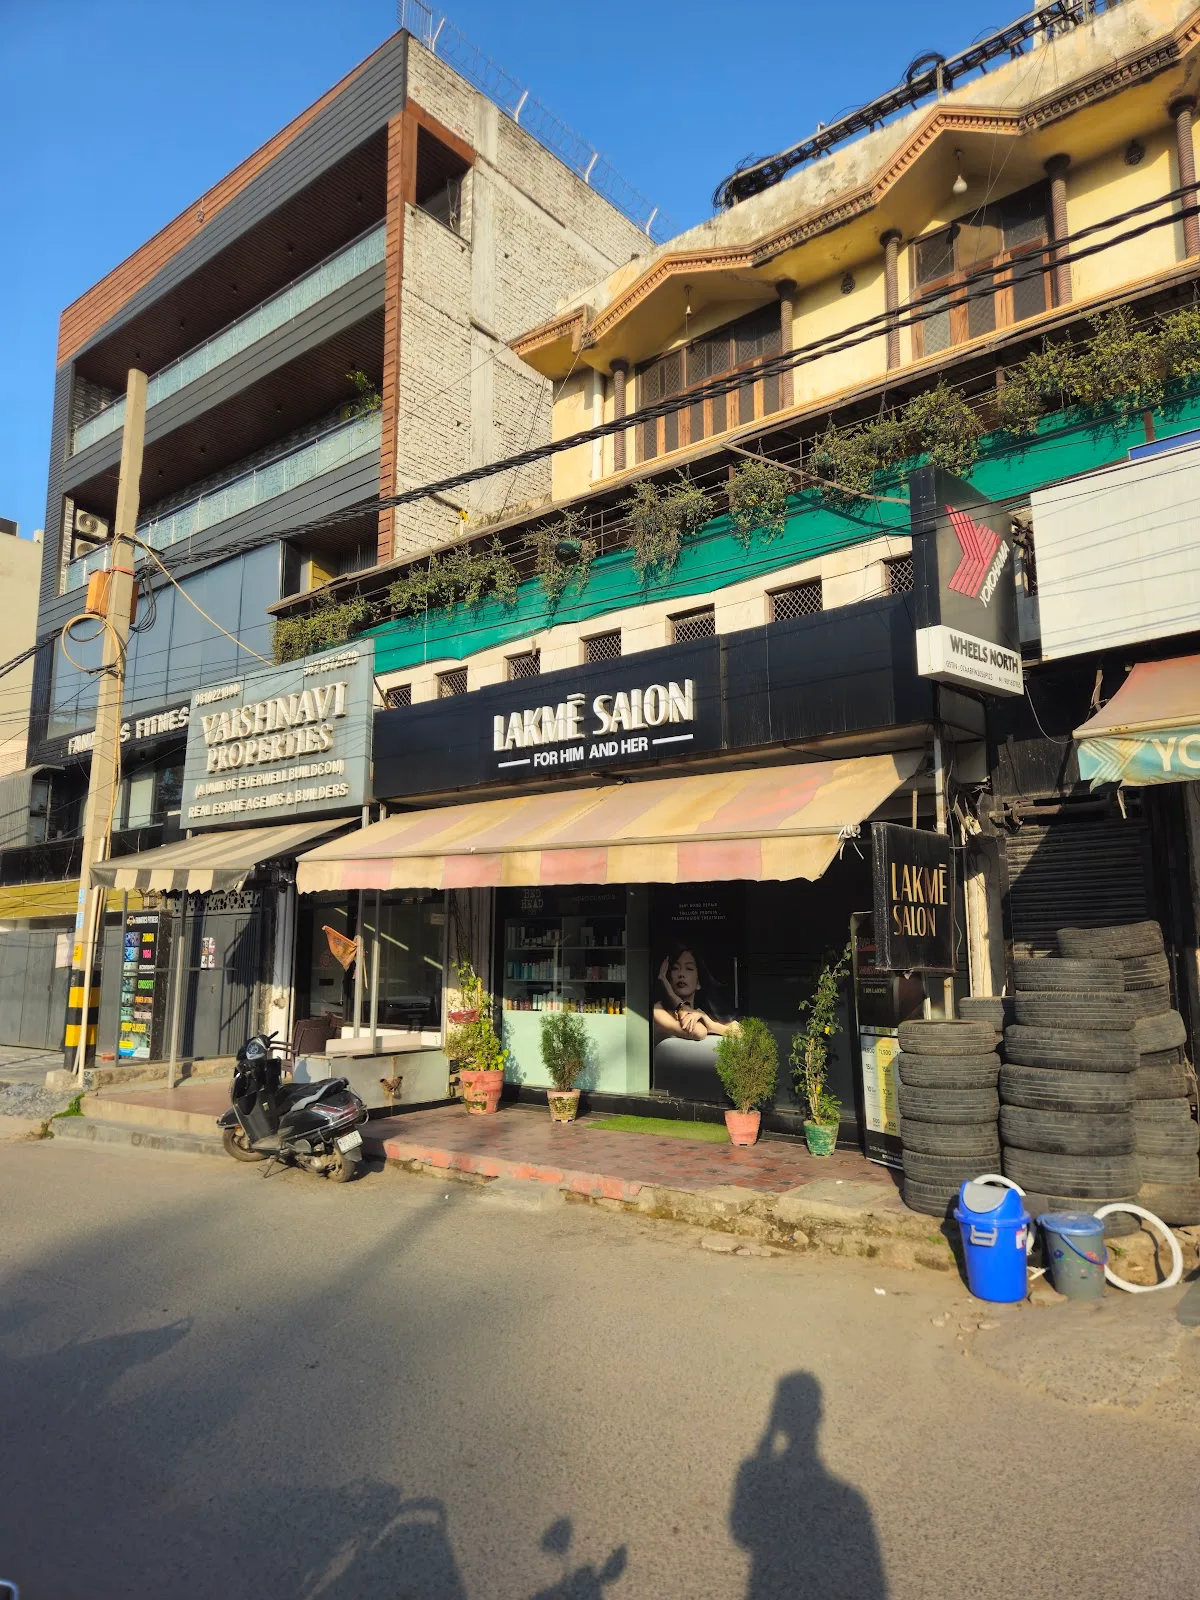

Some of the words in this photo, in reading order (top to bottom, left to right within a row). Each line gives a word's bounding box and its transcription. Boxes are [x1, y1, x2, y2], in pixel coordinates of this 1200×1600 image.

[979, 540, 1010, 608] YOKOHAMA
[950, 634, 989, 663] WHEELS
[989, 648, 1019, 674] NORTH
[201, 681, 348, 746] VAISHNAVI
[592, 679, 694, 736] SALON
[207, 723, 333, 773] PROPERTIES
[533, 751, 558, 767] FOR
[560, 746, 585, 763] HIM
[589, 741, 619, 759] AND
[621, 736, 650, 755] HER
[226, 777, 239, 791] OF
[239, 769, 288, 789] EVERWELL
[188, 804, 213, 819] REAL
[213, 799, 246, 815] ESTATE
[246, 792, 285, 811] AGENTS
[286, 792, 294, 805] &
[295, 782, 348, 803] BUILDERS
[521, 899, 544, 909] HEAD
[524, 888, 542, 898] BED
[893, 904, 937, 937] SALON
